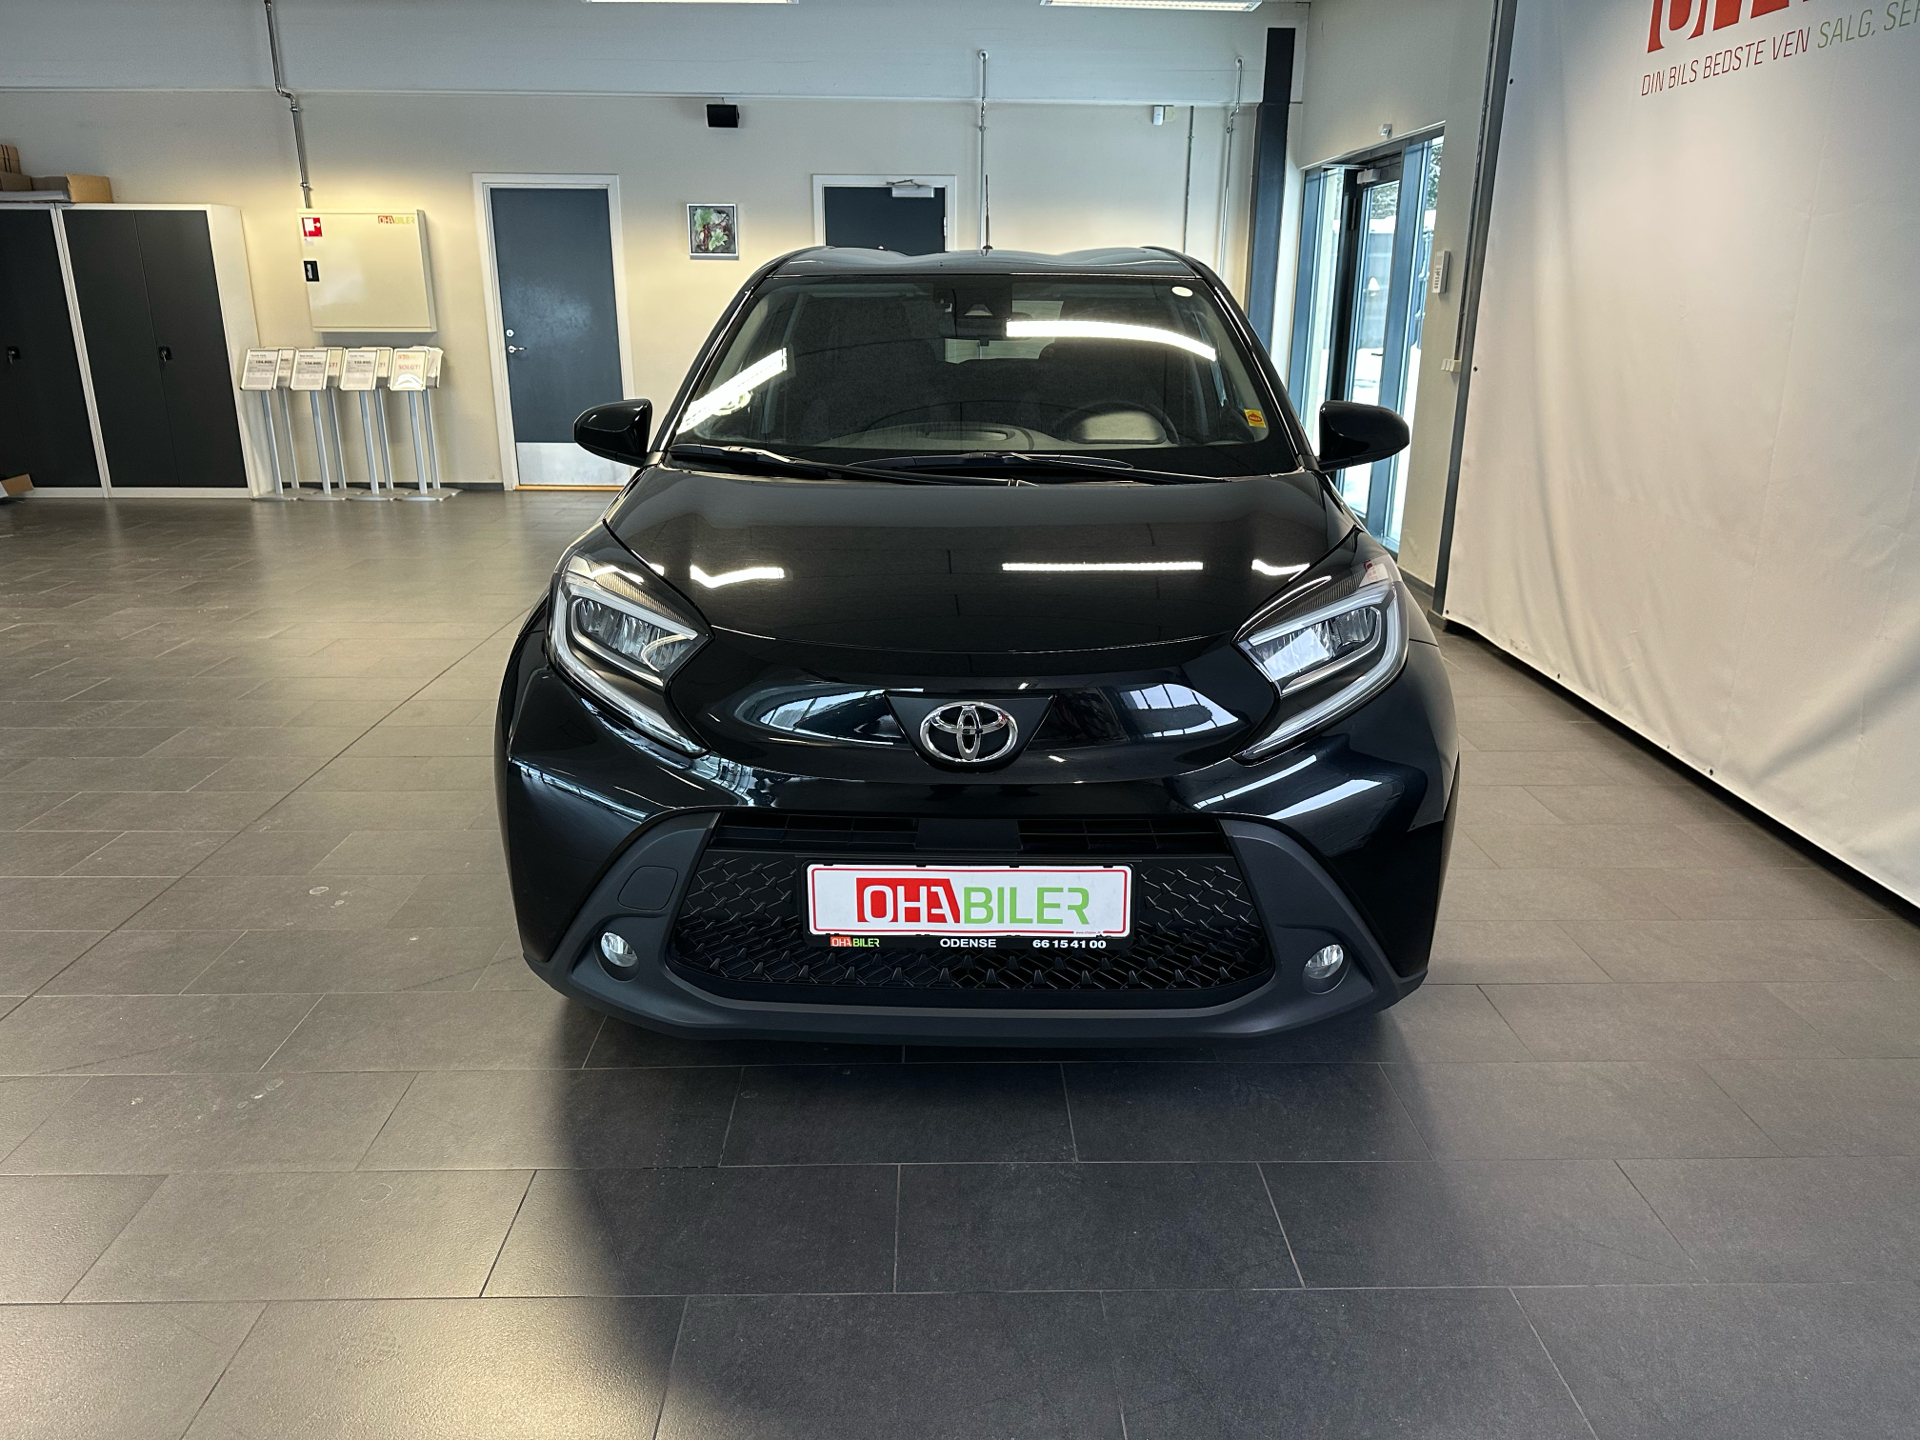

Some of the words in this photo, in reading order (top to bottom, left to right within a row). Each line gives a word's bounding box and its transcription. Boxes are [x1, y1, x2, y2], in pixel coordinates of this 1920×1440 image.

[1641, 69, 1666, 96] DIN
[1668, 60, 1699, 89] BILS
[1703, 39, 1766, 79] BEDSTE
[1772, 26, 1811, 60] VEN
[1817, 8, 1876, 49] SALG,
[939, 938, 997, 948] ODENSE
[1032, 939, 1050, 949] 66
[1052, 940, 1069, 949] 15
[1070, 940, 1086, 949] 41
[1089, 940, 1107, 949] 00
